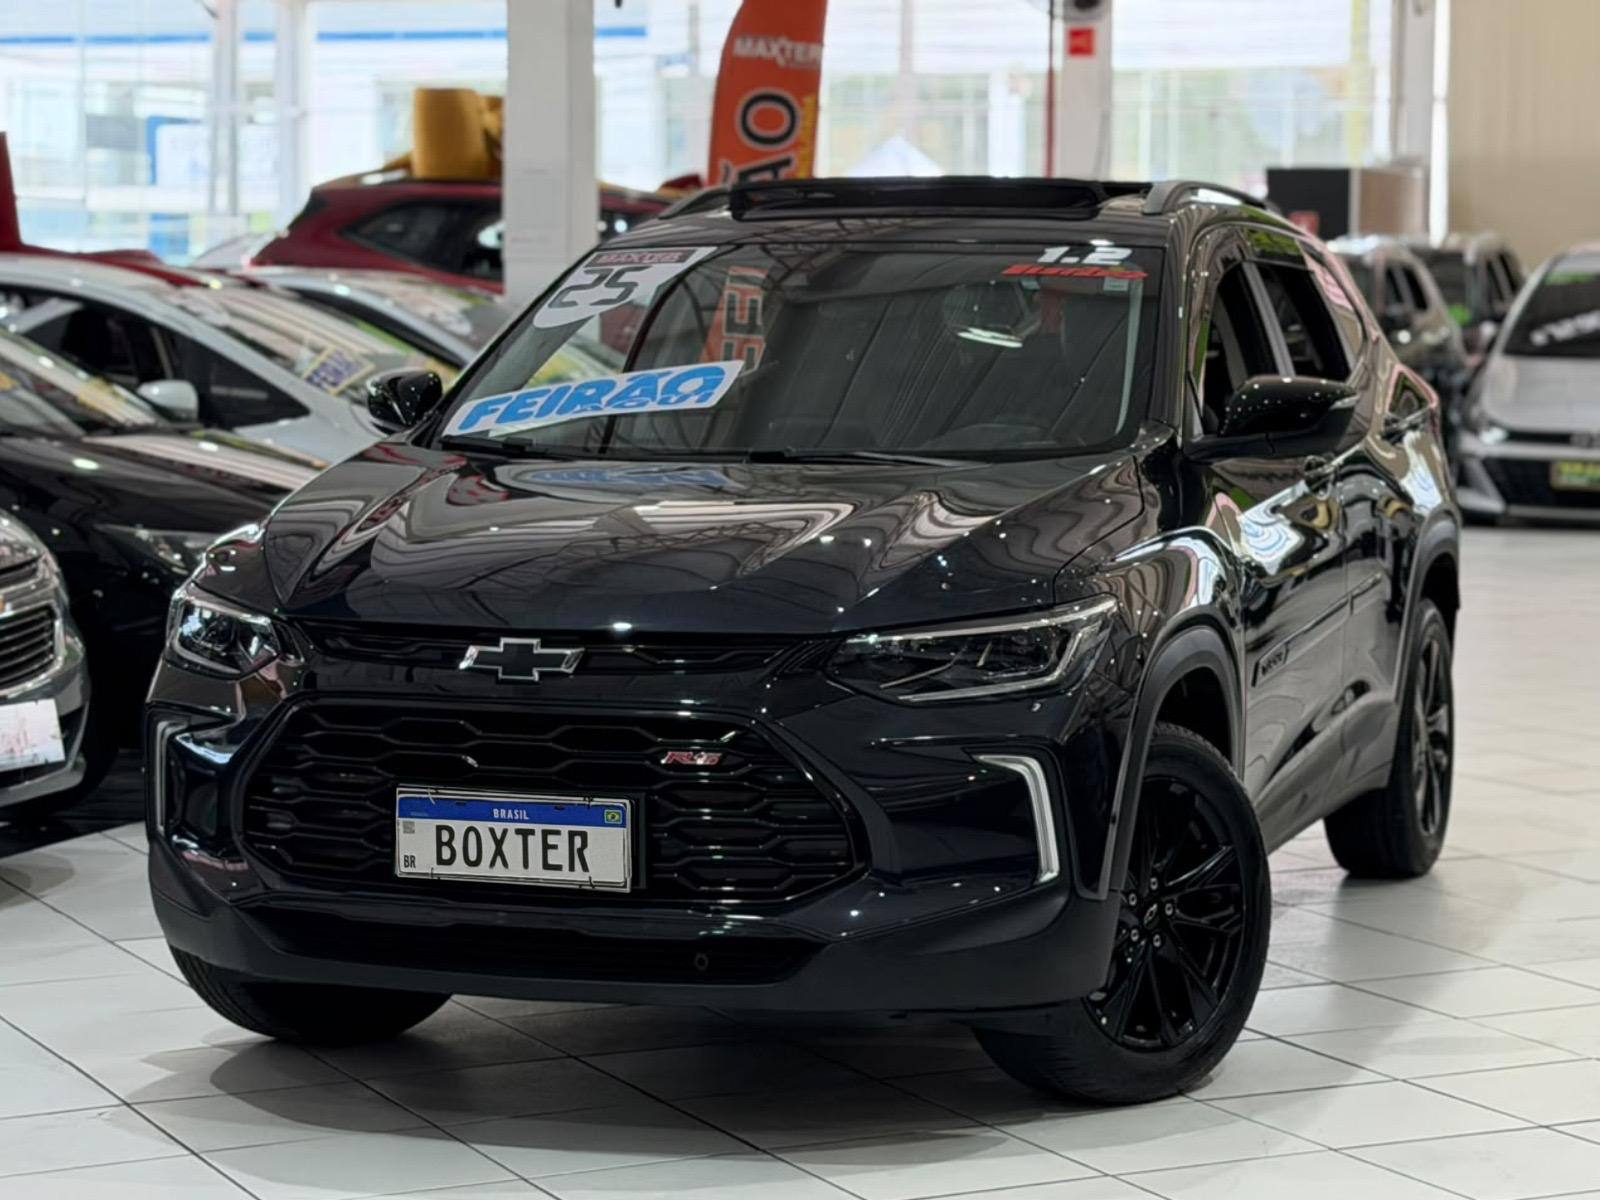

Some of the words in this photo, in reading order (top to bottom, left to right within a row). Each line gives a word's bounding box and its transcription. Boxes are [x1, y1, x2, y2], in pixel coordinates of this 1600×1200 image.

[1037, 245, 1133, 265] 1.2
[548, 265, 653, 308] 25
[457, 366, 727, 432] FEIRÃO
[493, 808, 530, 820] BRASIL
[403, 855, 416, 868] BR
[435, 824, 590, 873] BOXTER
